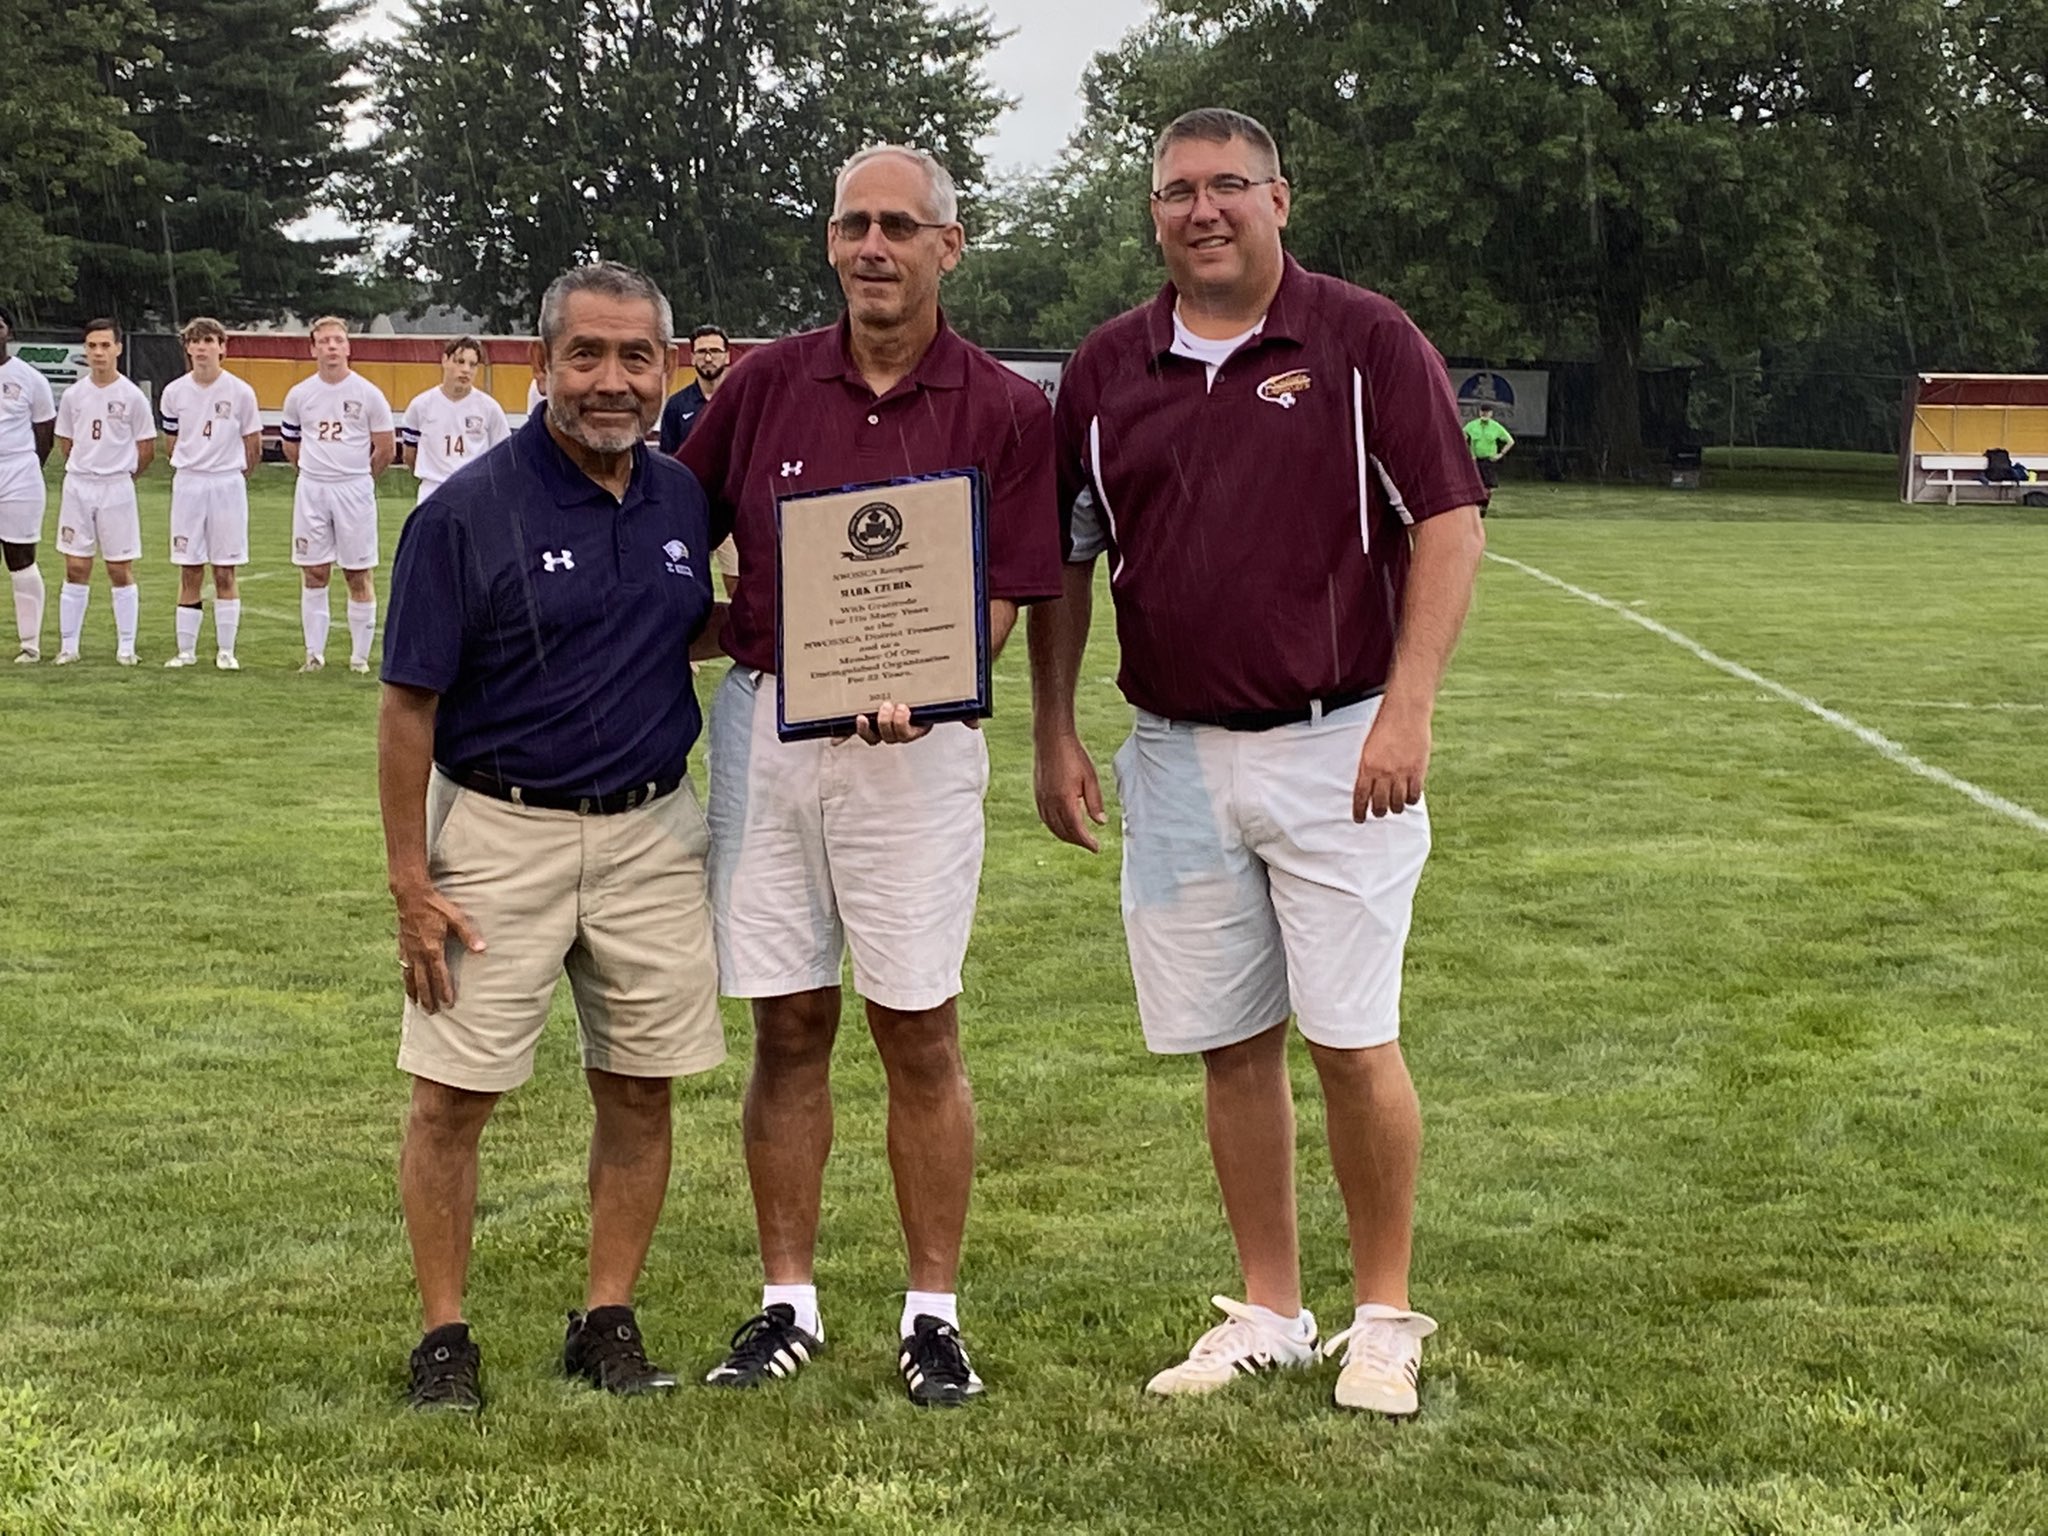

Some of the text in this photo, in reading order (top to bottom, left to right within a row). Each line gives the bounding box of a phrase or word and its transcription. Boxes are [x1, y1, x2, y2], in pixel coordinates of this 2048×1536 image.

[92, 419, 102, 440] 8
[202, 420, 212, 440] 4
[318, 421, 342, 441] 22
[445, 435, 465, 456] 14
[840, 587, 871, 598] MARK
[840, 605, 866, 614] With
[870, 612, 898, 622] Many
[901, 606, 929, 616] Years
[878, 621, 894, 630] the
[803, 635, 862, 650] NWOSSCA
[865, 630, 903, 641] District
[859, 642, 878, 652] and
[839, 647, 922, 665] Member Of Our
[847, 676, 865, 685] For
